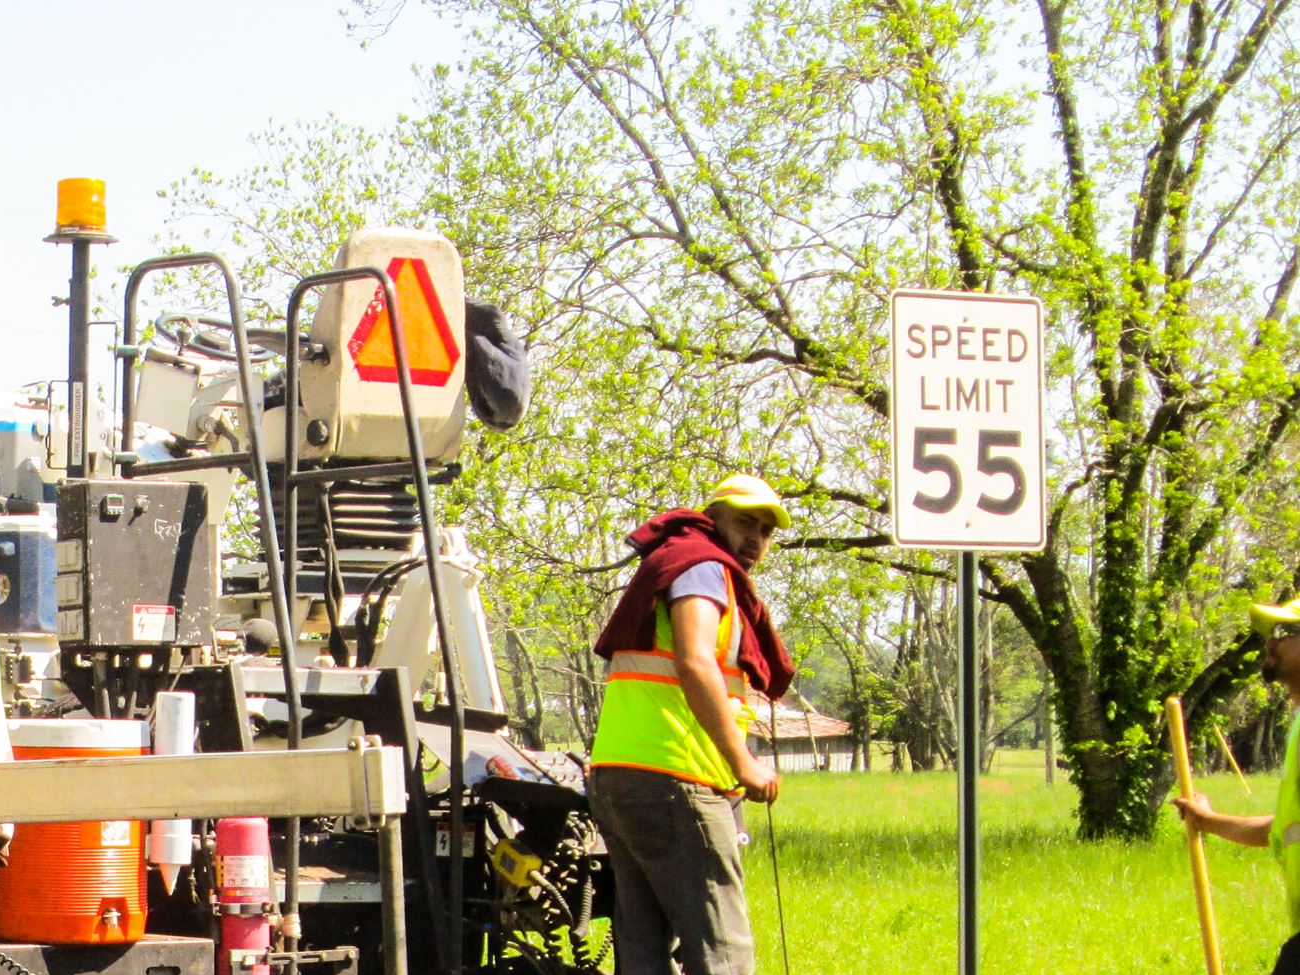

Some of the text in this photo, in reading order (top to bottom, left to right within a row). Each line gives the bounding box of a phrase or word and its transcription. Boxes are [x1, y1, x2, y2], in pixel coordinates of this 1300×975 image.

[906, 323, 1029, 363] SPEED
[920, 375, 1015, 413] LIMIT
[912, 426, 1027, 516] 55
